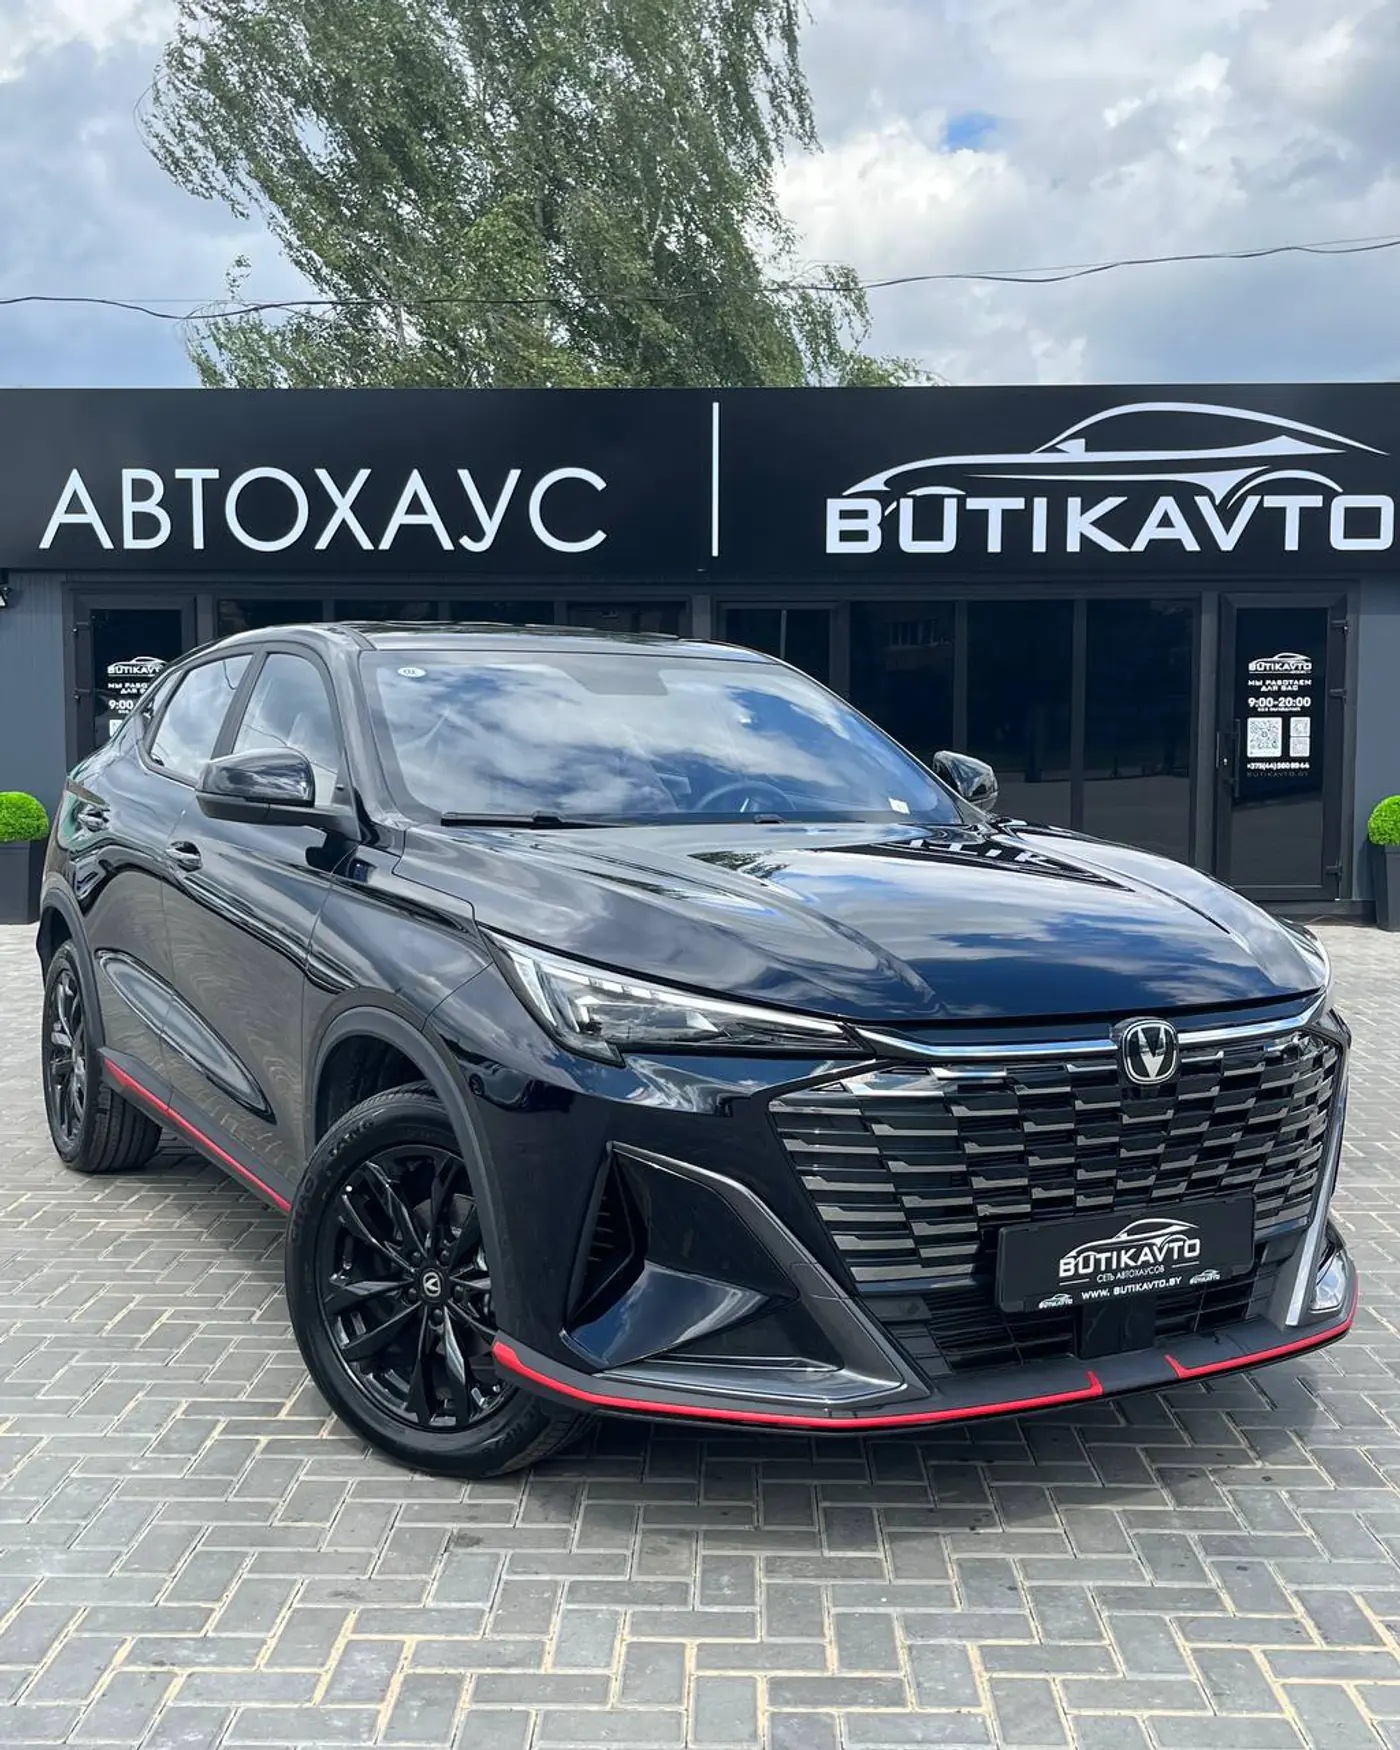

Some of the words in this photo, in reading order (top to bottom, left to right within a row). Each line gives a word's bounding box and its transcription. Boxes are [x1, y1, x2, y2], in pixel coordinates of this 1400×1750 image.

[38, 466, 607, 553] АВТОХАУС
[825, 494, 1395, 555] BUTIKAVTO
[1248, 662, 1312, 671] BUTIKAVTO
[1248, 697, 1312, 708] 9:00-20:00
[1058, 1238, 1201, 1278] BUTIKAVTO
[1096, 1272, 1115, 1284] СЕТЬ
[1115, 1264, 1165, 1280] АВТОХАУСОВ
[1113, 1276, 1182, 1296] BUTIKAVTO.BY
